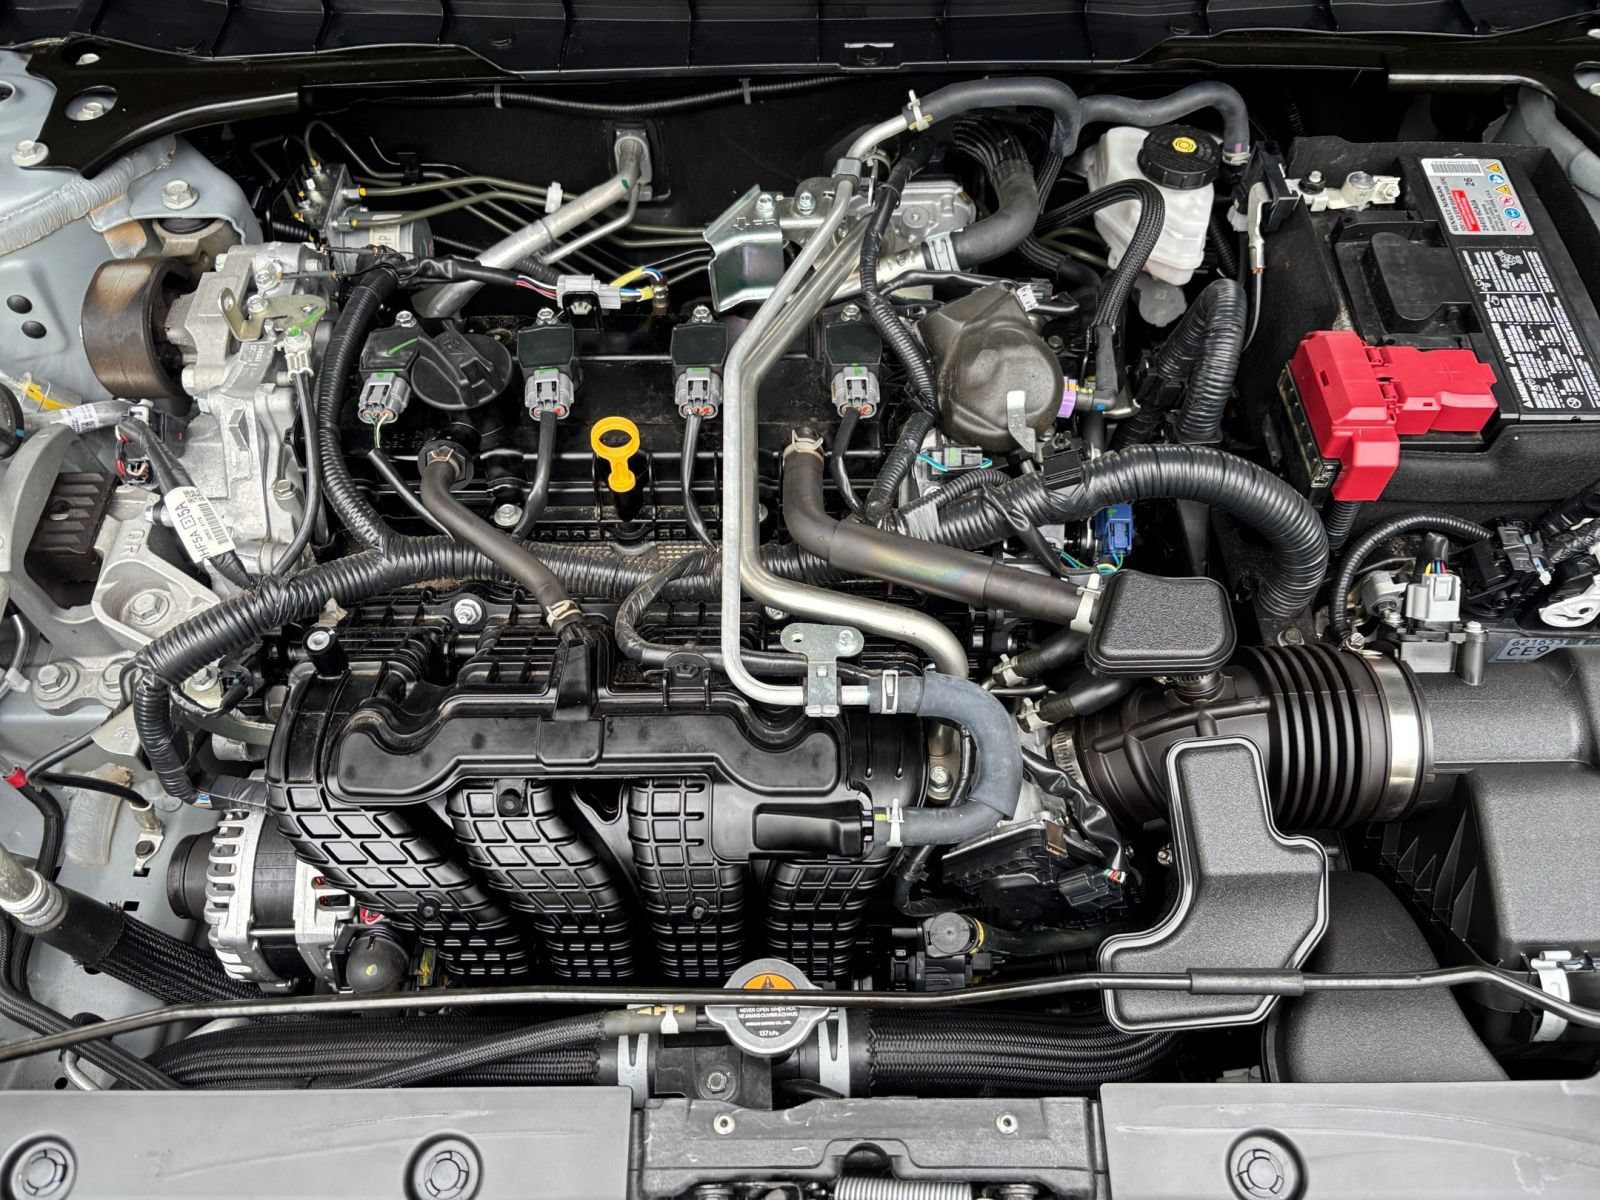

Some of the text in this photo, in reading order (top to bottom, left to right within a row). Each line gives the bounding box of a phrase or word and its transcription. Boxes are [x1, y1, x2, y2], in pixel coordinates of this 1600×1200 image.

[1464, 177, 1475, 186] 26
[1436, 185, 1449, 207] NISSAN
[1445, 209, 1459, 231] RENAULT
[175, 501, 190, 518] 5A
